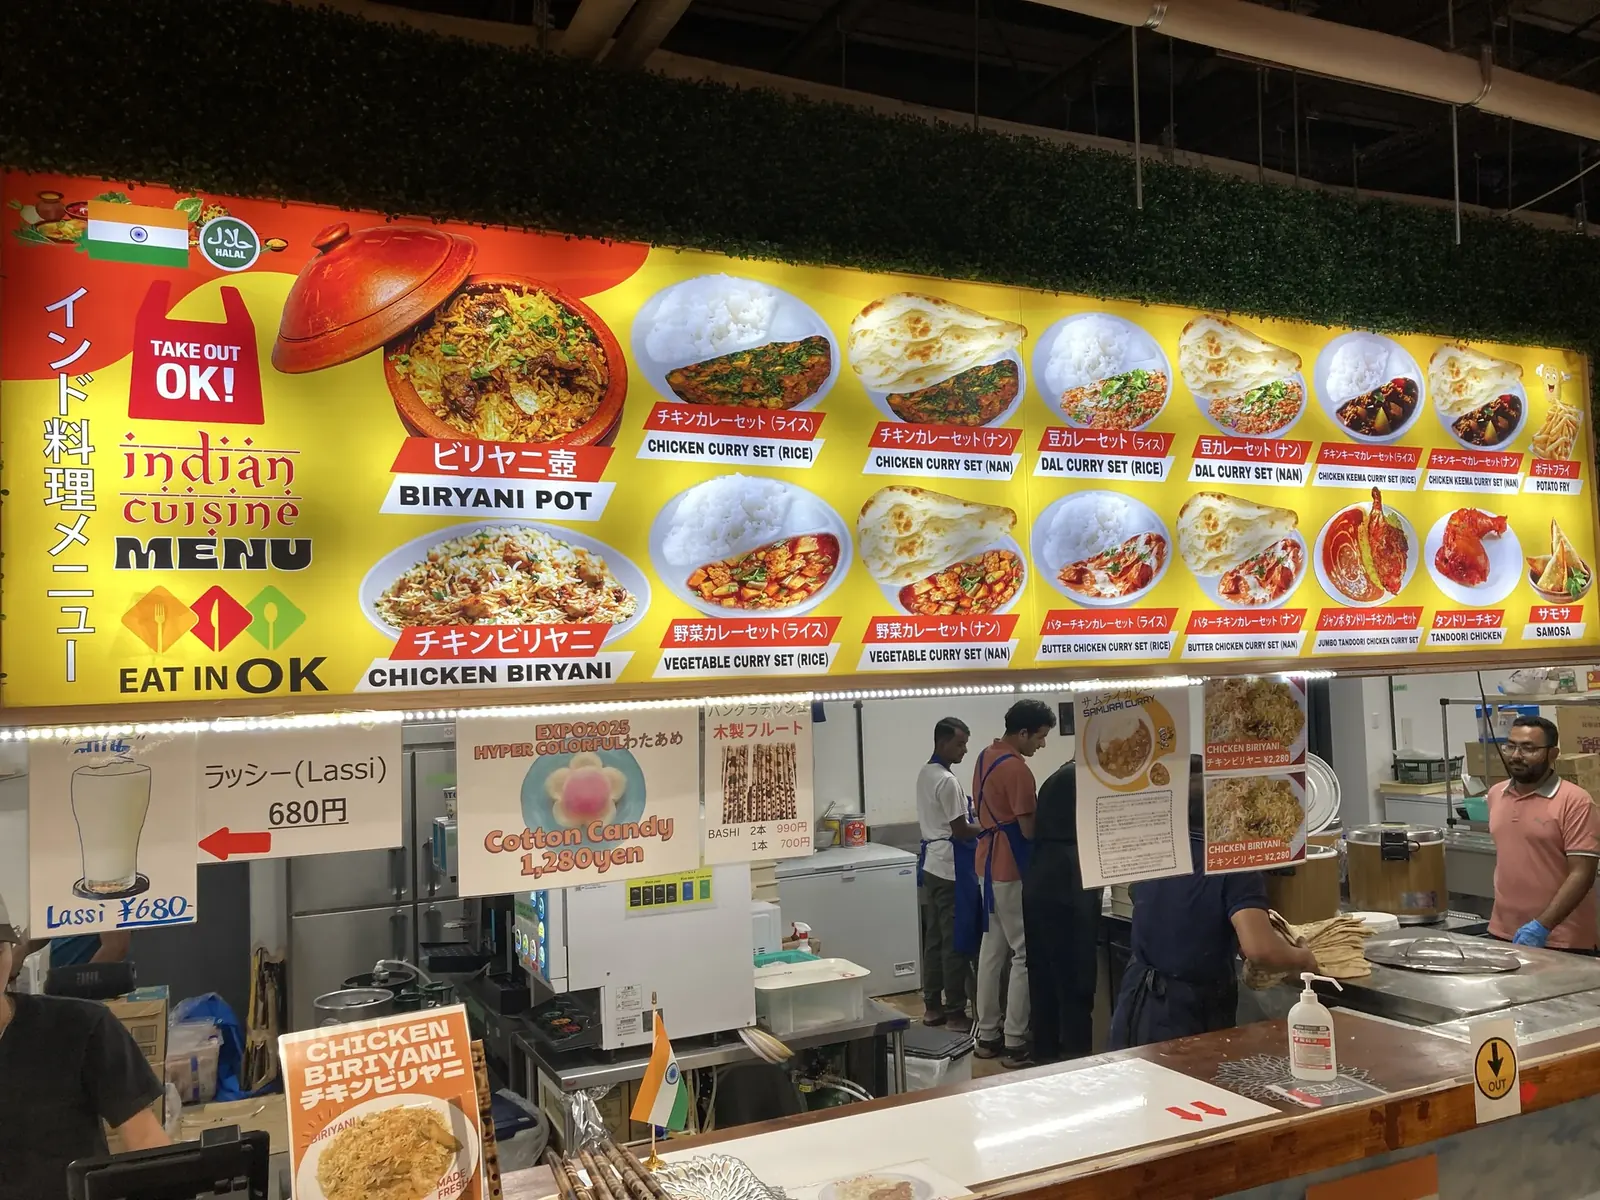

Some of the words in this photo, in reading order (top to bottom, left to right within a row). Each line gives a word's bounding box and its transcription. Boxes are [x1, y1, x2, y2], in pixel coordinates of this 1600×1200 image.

[215, 247, 246, 260] HALAL
[150, 339, 200, 358] TAKE
[204, 342, 241, 361] OUT
[155, 362, 235, 404] OK!
[123, 430, 295, 489] indian
[433, 441, 578, 479] ビリヤニ壺
[647, 438, 705, 455] CHICKEN
[707, 441, 749, 458] CURRY
[752, 444, 775, 459] SET
[778, 445, 814, 462] (RICE)
[875, 455, 923, 469] CHICKEN
[926, 457, 961, 471] CURRY
[964, 459, 983, 472] SET
[985, 459, 1014, 475] (NAN)
[1041, 457, 1064, 472] DAL
[1066, 458, 1105, 473] CURRY
[1107, 460, 1129, 474] SET
[1131, 460, 1164, 478] (RICE)
[1195, 464, 1215, 478] DAL
[1217, 465, 1252, 480] CURRY
[1253, 467, 1273, 481] SET
[1275, 468, 1303, 484] (NAN)
[44, 286, 97, 683] インド料理メニュー
[1318, 471, 1346, 481] CHICKEN
[1346, 473, 1367, 483] KEEMA
[1367, 474, 1387, 484] CURRY
[1387, 475, 1399, 484] SET
[1399, 475, 1417, 486] (RICE)
[1428, 475, 1454, 485] CHICKEN
[1454, 476, 1474, 486] KEEMA
[1474, 477, 1492, 487] CURRY
[1492, 478, 1503, 488] SET
[1503, 478, 1519, 490] (NAN)
[1536, 480, 1559, 492] POTATO
[1559, 482, 1570, 493] FRY
[399, 485, 525, 509] BIRYANI
[535, 489, 593, 511] POT
[122, 490, 300, 532] cuisine
[113, 536, 313, 571] MENU
[1436, 613, 1501, 628] タンドリーチキン
[1537, 607, 1571, 620] サモサ
[413, 627, 595, 657] チキンビリヤニ
[1318, 638, 1338, 647] JUMBO
[1338, 638, 1366, 647] TANDOORI
[1366, 637, 1390, 646] CHICKEN
[1391, 636, 1408, 645] CURRY
[1408, 636, 1419, 645] SET
[1431, 632, 1469, 643] TANDOORI
[1469, 631, 1502, 642] CHICKEN
[1535, 626, 1572, 638] SAMOSA
[869, 649, 927, 663] VEGETABLE
[929, 648, 962, 661] CURRY
[964, 647, 982, 660] SET
[984, 645, 1011, 661] (NAN)
[1041, 643, 1072, 654] BUTTER
[1073, 642, 1107, 653] CHICKEN
[1108, 641, 1133, 652] CURRY
[1134, 641, 1149, 651] SET
[1150, 640, 1171, 653] (RICE)
[1187, 642, 1214, 652] BUTTER
[1214, 642, 1244, 651] CHICKEN
[1245, 641, 1267, 650] CURRY
[1267, 640, 1280, 649] SET
[1280, 639, 1298, 650] (NAN)
[663, 655, 731, 671] VEGETABLE
[733, 654, 771, 669] CURRY
[774, 653, 795, 668] SET
[797, 652, 829, 669] (RICE)
[119, 667, 184, 694] EAT
[194, 665, 228, 690] IN
[235, 656, 329, 694] OK
[367, 664, 498, 688] CHICKEN
[506, 661, 613, 684] BIRYANI
[1083, 700, 1125, 718] SAMURAI
[1124, 694, 1155, 709] CURRY
[535, 719, 631, 742] EXPO2025
[713, 720, 803, 741] 木製フルート
[474, 741, 534, 761] HYPER
[1206, 744, 1245, 754] CHICKEN
[1245, 742, 1280, 753] BIRIYANI
[1206, 755, 1262, 767] チキンビリヤニ
[1263, 754, 1289, 765] ¥2,280
[268, 797, 348, 826] 680円
[484, 825, 581, 854] Cotton
[586, 814, 675, 842] Candy
[708, 827, 740, 840] BASHI
[750, 823, 767, 836] 2本
[776, 821, 808, 834] 990円
[751, 839, 768, 853] 1本
[780, 836, 811, 849] 700円
[1208, 844, 1246, 855] CHICKEN
[1247, 840, 1281, 851] BIRIYANI
[520, 846, 645, 880] 1,280yen
[1208, 855, 1263, 868] チキンビリヤニ
[1264, 850, 1290, 862] ¥2,280
[46, 903, 106, 929] Lassi
[306, 1020, 450, 1062] CHICKEN
[304, 1039, 456, 1087] BIRIYANI
[300, 1059, 465, 1111] チキンビリヤニ
[1488, 1079, 1507, 1093] OUT
[311, 1116, 357, 1144] BIRIYANI
[436, 1168, 467, 1190] MADE
